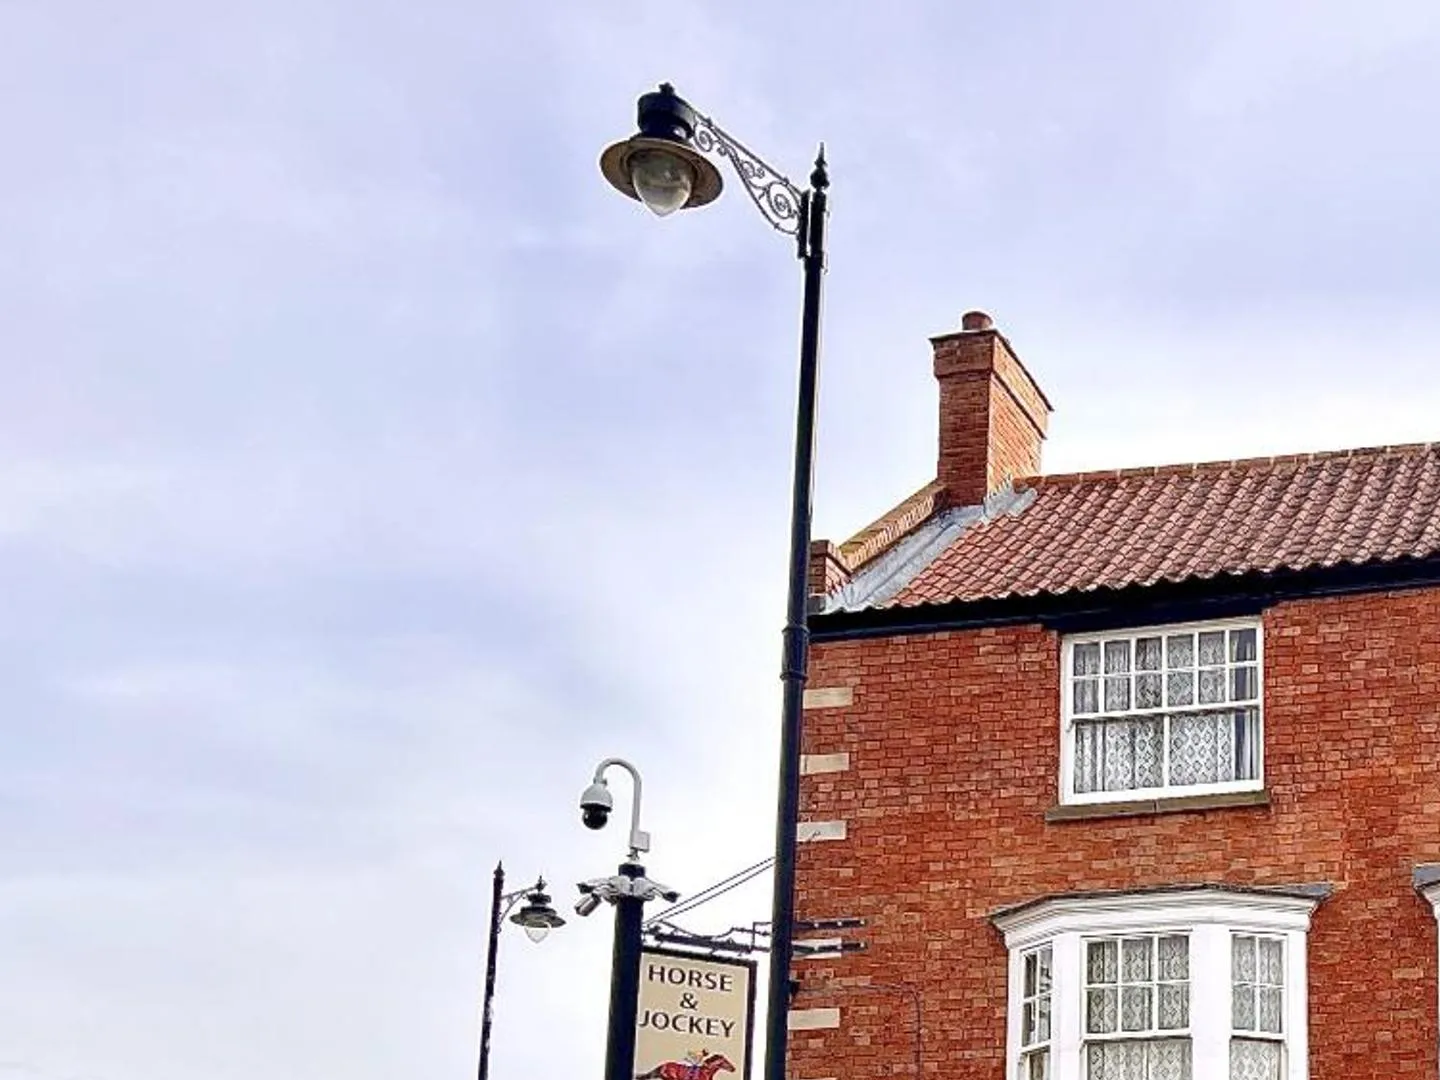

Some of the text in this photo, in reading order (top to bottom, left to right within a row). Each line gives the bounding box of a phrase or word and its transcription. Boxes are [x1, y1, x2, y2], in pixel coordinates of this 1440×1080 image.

[649, 965, 733, 992] HORSE
[680, 992, 698, 1011] &
[638, 1010, 735, 1038] JOCKEY
